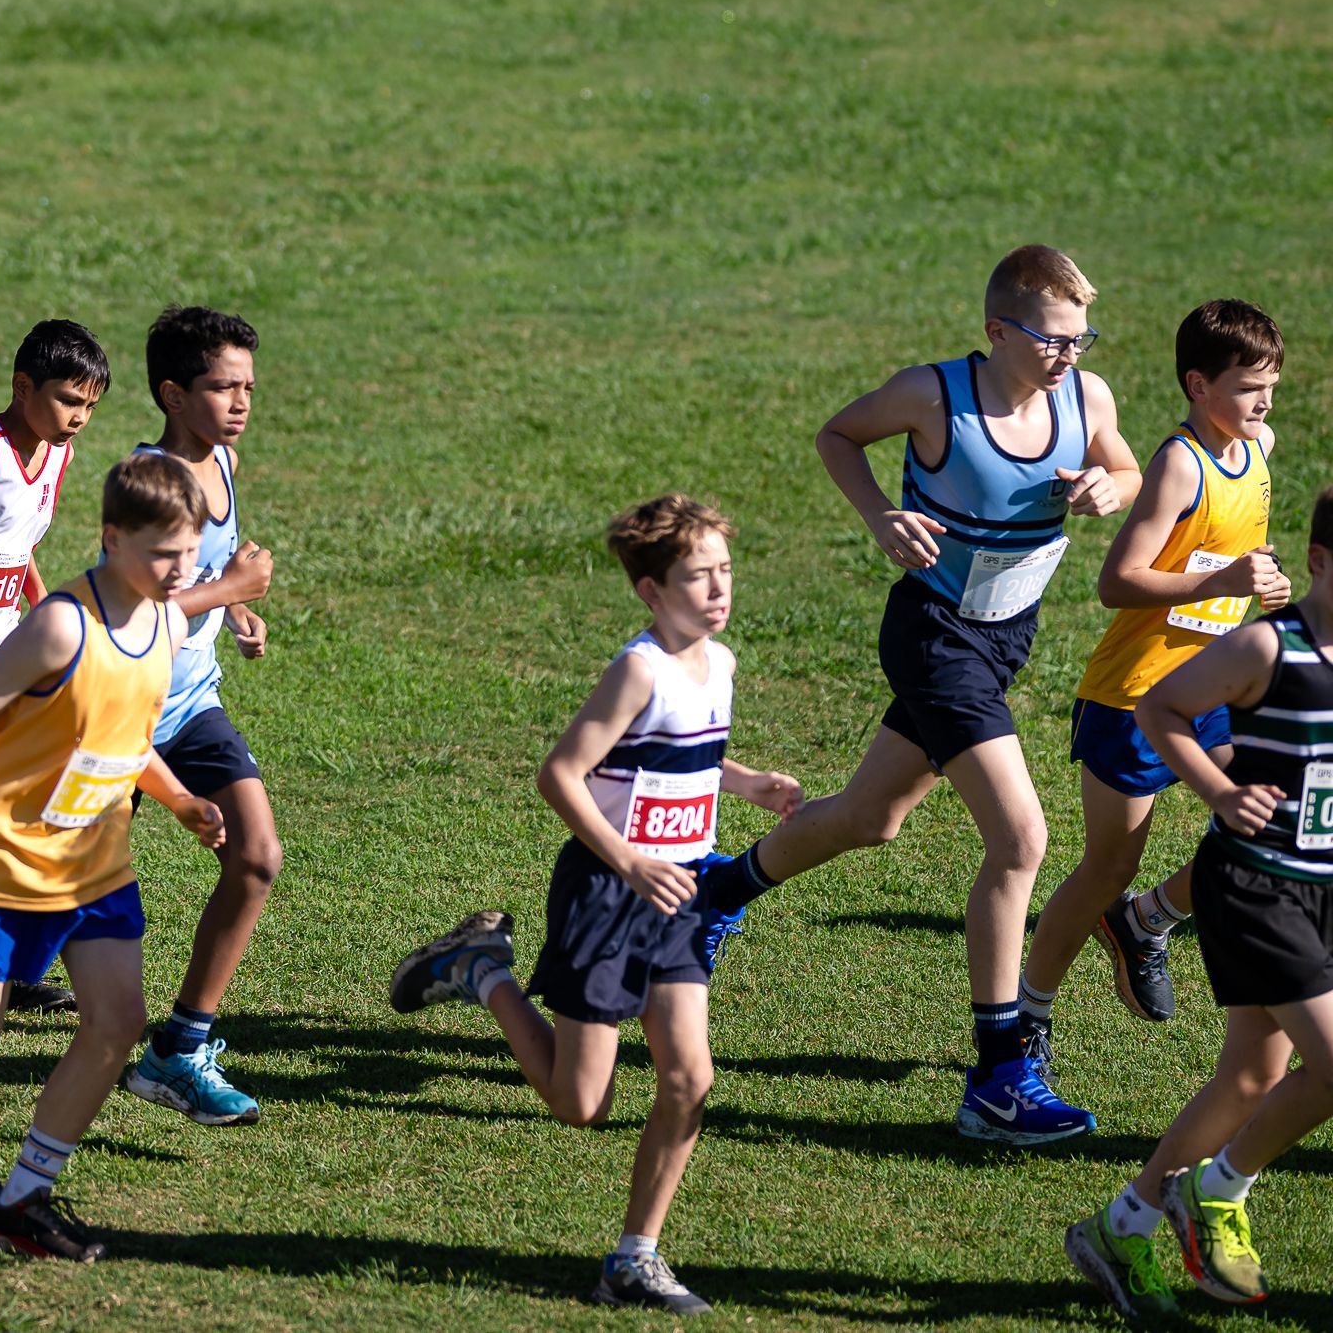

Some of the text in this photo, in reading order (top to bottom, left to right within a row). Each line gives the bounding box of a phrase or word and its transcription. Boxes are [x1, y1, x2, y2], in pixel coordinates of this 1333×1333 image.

[983, 555, 1000, 565] GPS
[1198, 556, 1213, 567] GPS
[987, 569, 1047, 603] 1208
[629, 799, 645, 838] TSS
[644, 803, 706, 838] 8204
